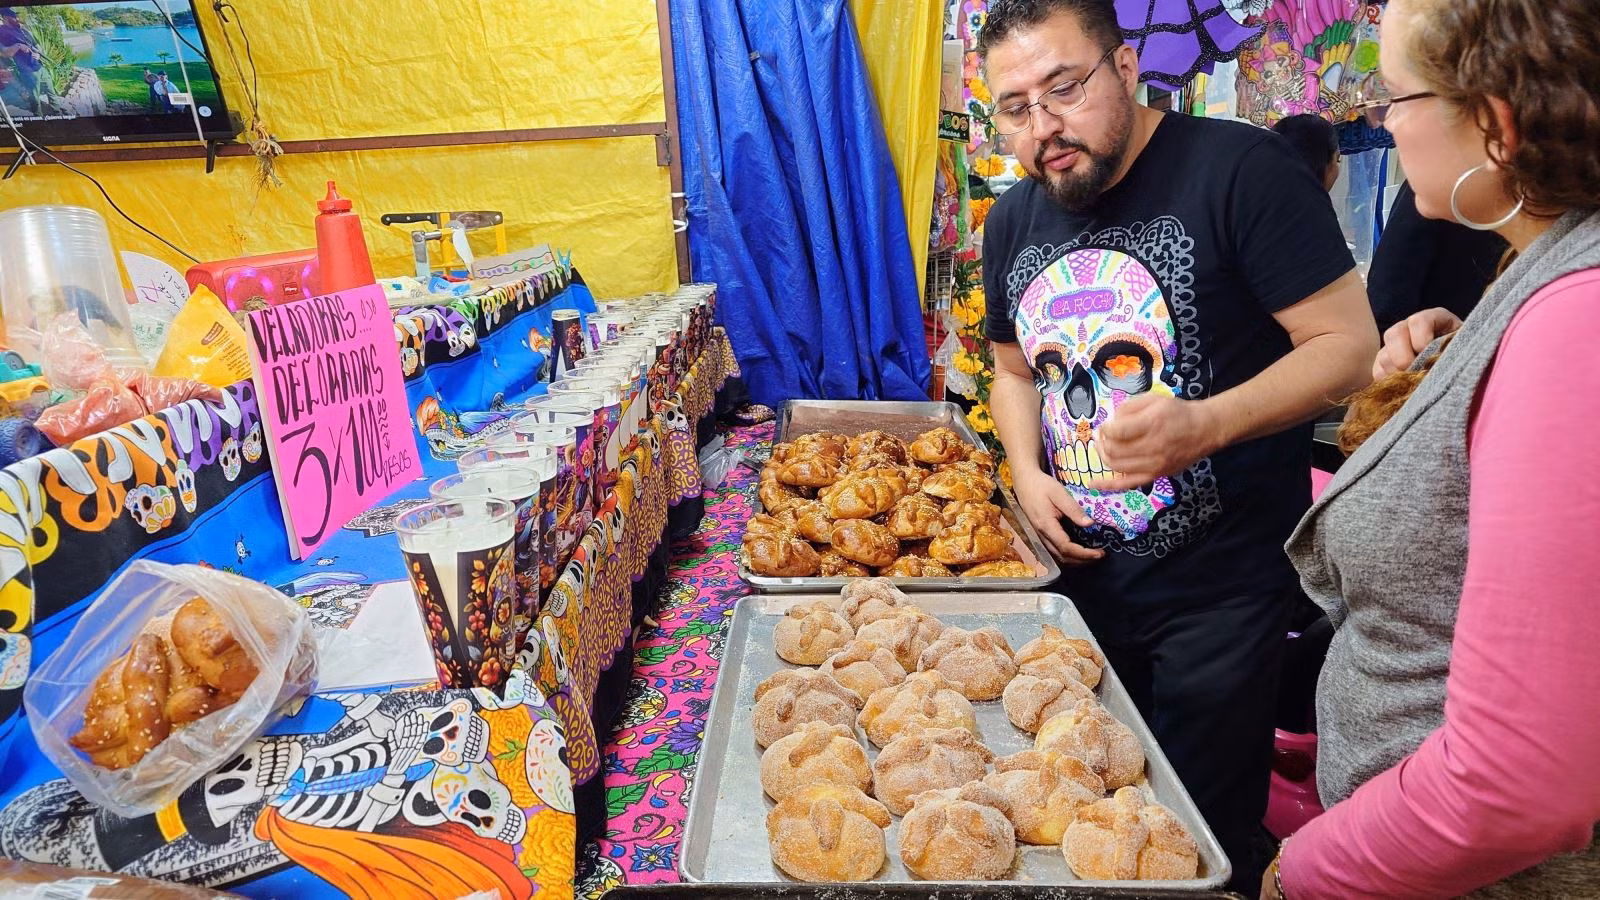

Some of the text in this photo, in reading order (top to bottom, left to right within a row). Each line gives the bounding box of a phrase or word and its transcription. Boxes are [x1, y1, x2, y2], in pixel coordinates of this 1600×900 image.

[248, 295, 356, 364] VELADORAS
[272, 343, 384, 425] DECORADAS
[383, 448, 412, 489] PESOS
